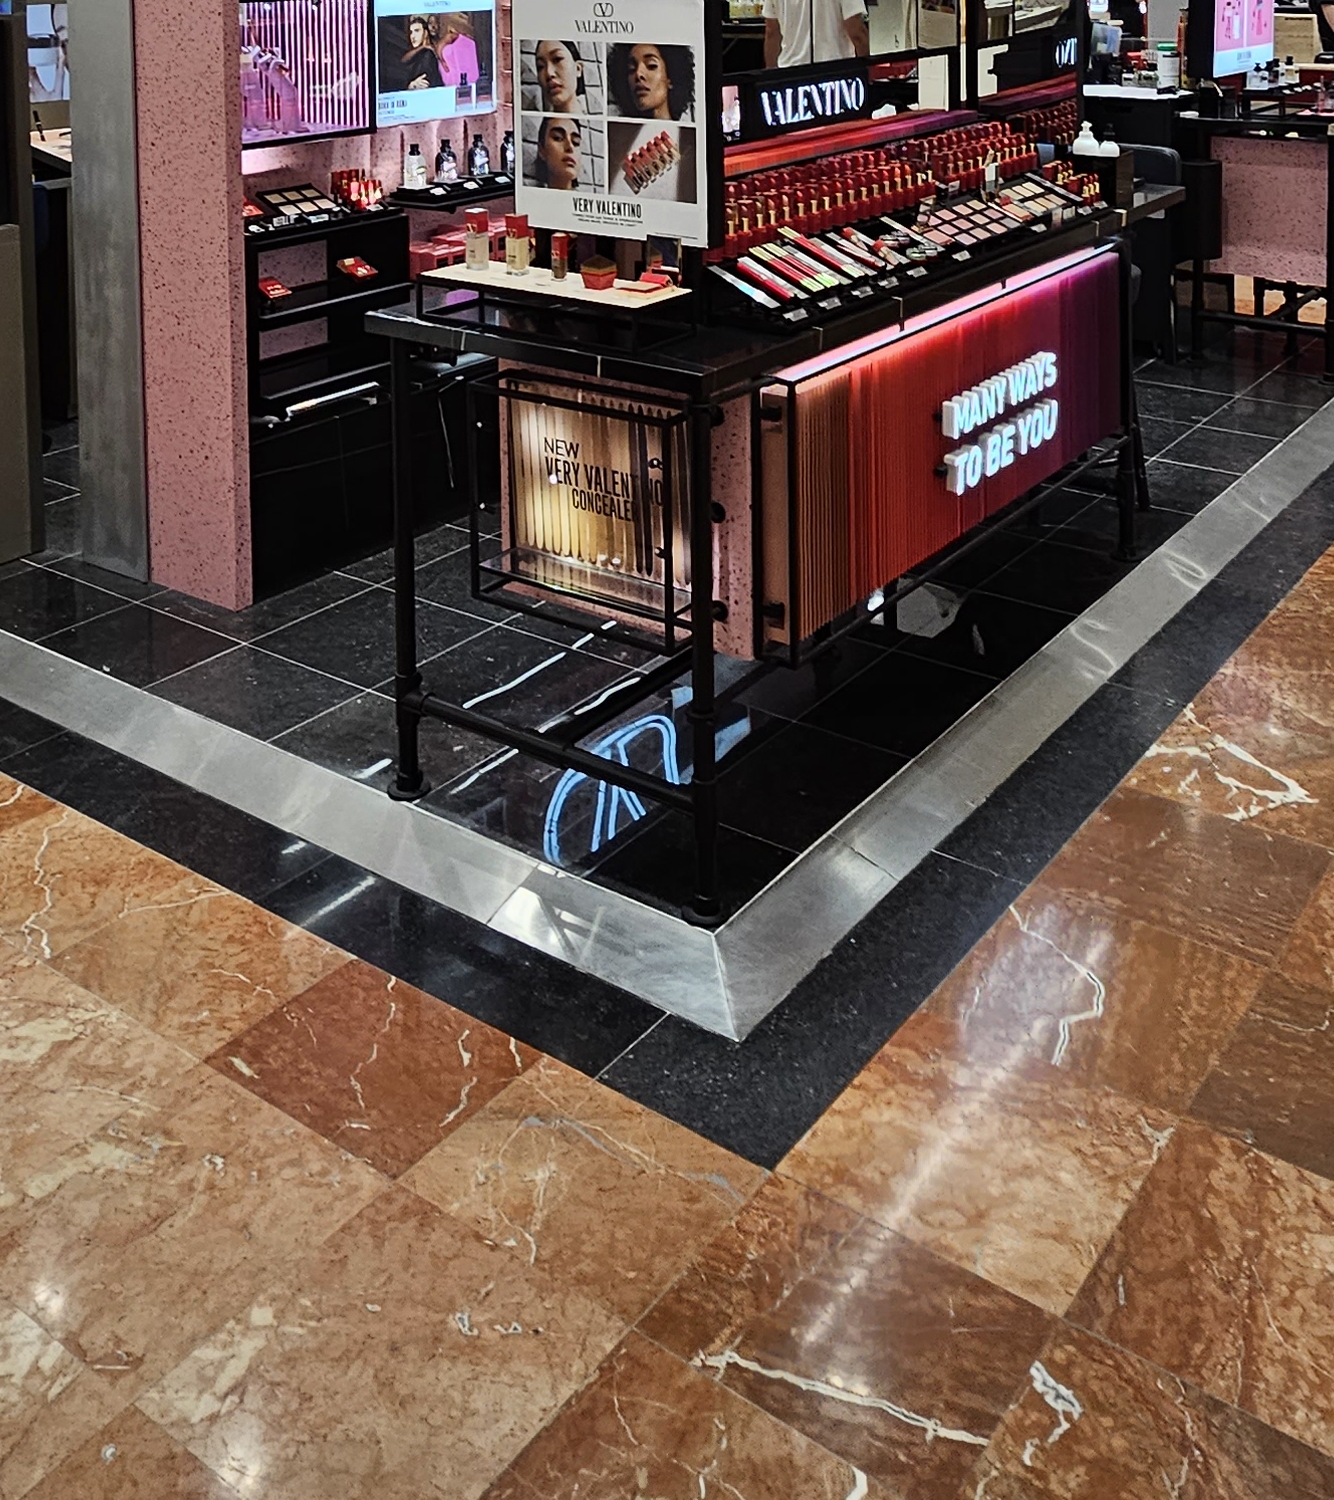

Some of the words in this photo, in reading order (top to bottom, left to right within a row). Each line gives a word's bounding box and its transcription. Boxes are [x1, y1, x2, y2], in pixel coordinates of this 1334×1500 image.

[574, 19, 634, 34] VALENTINO
[760, 77, 865, 126] VALENTINO
[572, 197, 595, 213] VERY
[595, 199, 642, 219] VALENTINO
[942, 376, 1007, 440] MANY
[1003, 351, 1058, 406] WAYS
[543, 436, 580, 459] NEW
[944, 444, 983, 497] TO
[981, 422, 1016, 477] BE
[1013, 398, 1059, 456] YOU
[544, 456, 580, 488] VERY
[583, 463, 664, 507] VALENTNO
[572, 488, 638, 523] CONCEALE
